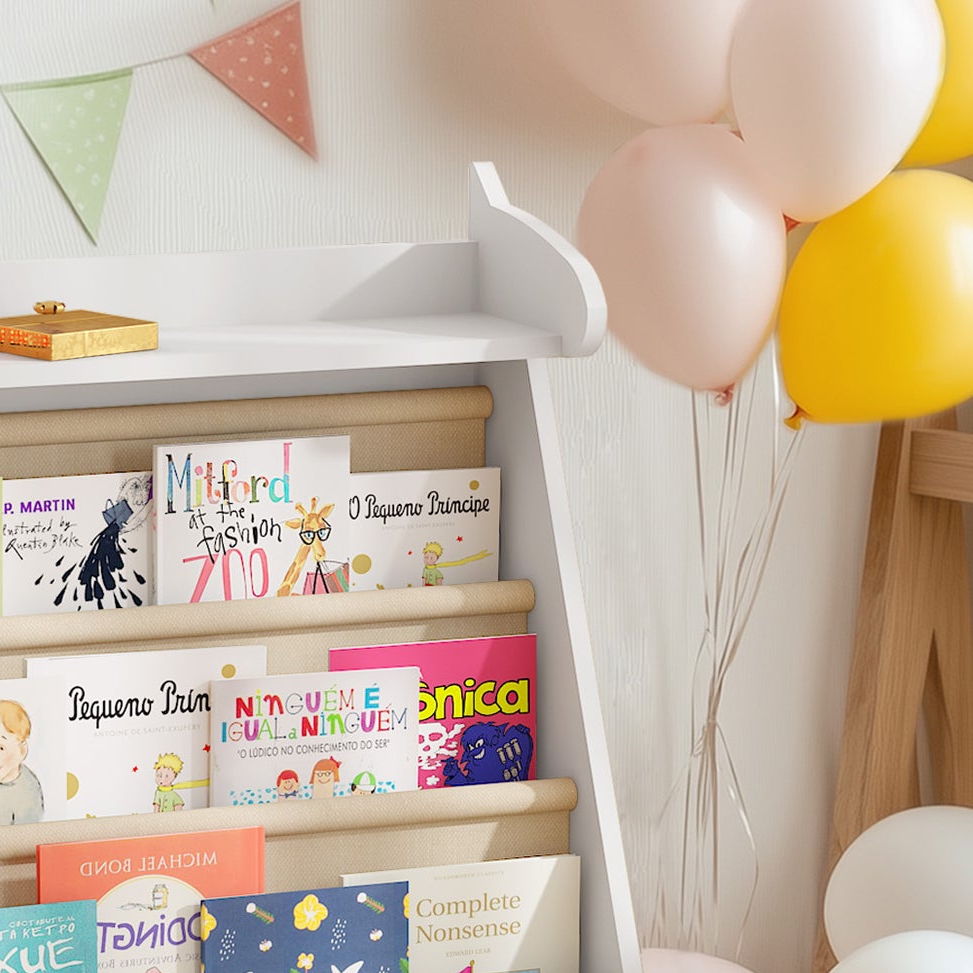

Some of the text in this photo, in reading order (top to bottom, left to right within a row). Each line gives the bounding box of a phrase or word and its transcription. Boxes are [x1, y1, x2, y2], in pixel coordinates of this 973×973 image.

[165, 442, 292, 515] Mitford
[4, 498, 75, 515] P. MARTIN
[189, 501, 245, 530] at the
[349, 490, 490, 525] O Pequeno Príncipe
[197, 513, 282, 564] fashion
[69, 686, 154, 729] Pequeno
[365, 682, 381, 709] É
[221, 717, 286, 743] IGUAL
[249, 745, 278, 758] LÚDICO
[281, 745, 294, 756] NO
[296, 741, 358, 754] CONHECIMENTO
[360, 740, 372, 751] DO
[416, 893, 521, 918] Complete
[23, 922, 75, 940] КЕТРО
[416, 920, 521, 944] Nonsense
